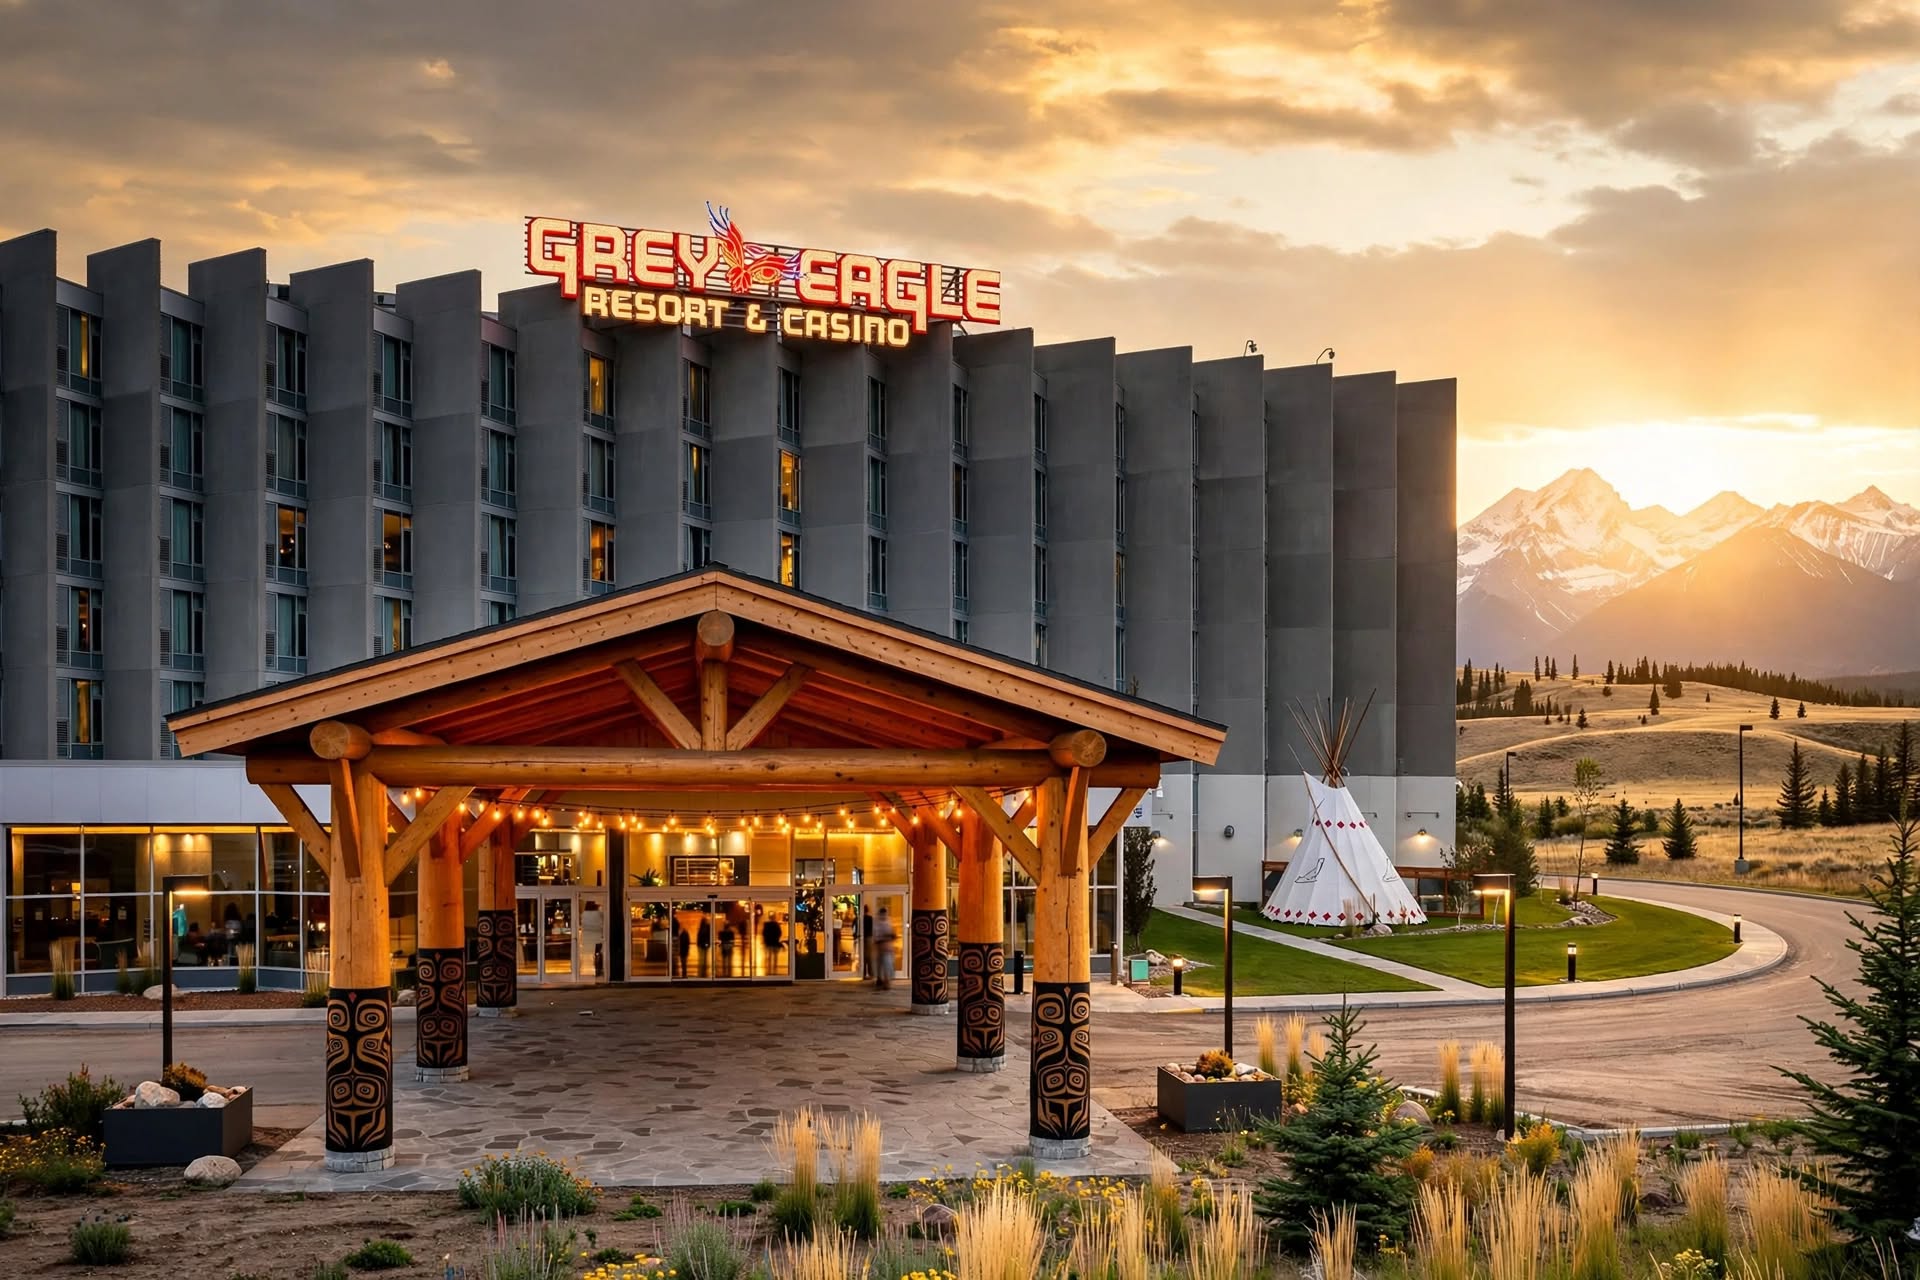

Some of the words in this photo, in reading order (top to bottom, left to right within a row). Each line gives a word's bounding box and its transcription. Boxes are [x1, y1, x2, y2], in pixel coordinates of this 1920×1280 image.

[528, 217, 720, 298] GREY
[796, 248, 1000, 334] EAGLE
[584, 286, 729, 328] RESORT
[746, 304, 767, 333] &
[783, 307, 909, 347] CASINO
